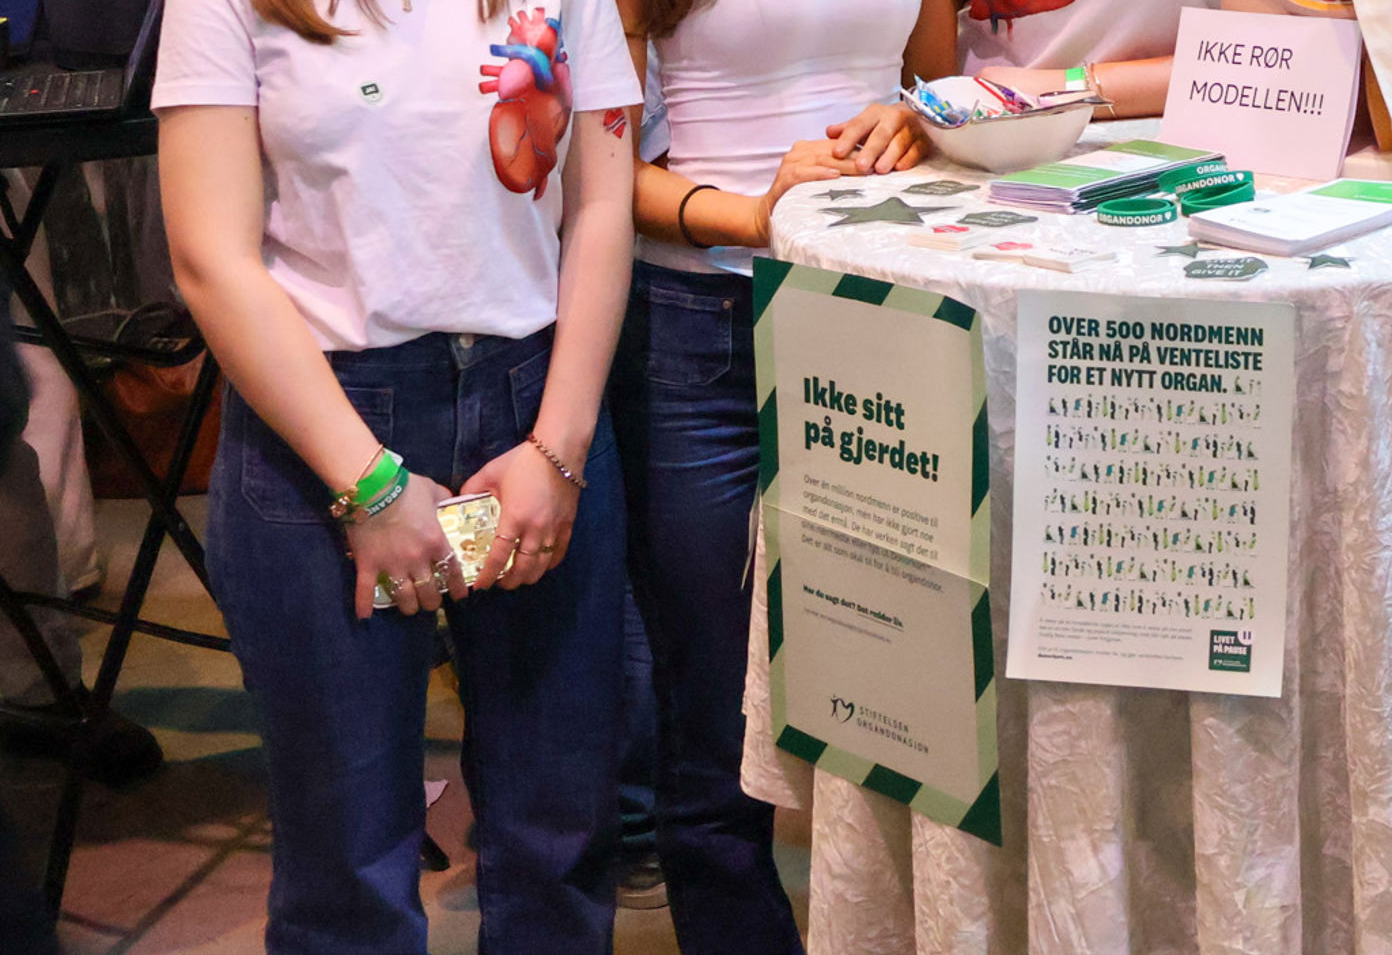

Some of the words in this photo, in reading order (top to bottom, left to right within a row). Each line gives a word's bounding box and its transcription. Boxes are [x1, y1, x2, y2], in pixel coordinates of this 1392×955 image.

[1197, 40, 1245, 65] IKKE
[1249, 45, 1293, 70] RØR
[1189, 80, 1324, 116] MODELLEN!!!
[1048, 316, 1100, 337] OVER
[1106, 320, 1144, 340] 500
[1150, 322, 1264, 346] NORDMENN
[1048, 338, 1094, 361] STÅR
[1099, 341, 1124, 362] NÅ
[1129, 342, 1151, 364] PÅ
[1156, 346, 1263, 371] VENTELISTE
[1047, 365, 1081, 385] FOR
[1086, 366, 1107, 385] ET
[1110, 367, 1157, 389] NYTT
[1161, 371, 1228, 394] ORGAN.
[803, 376, 857, 415] Ikke
[862, 392, 905, 430] sitt
[804, 416, 834, 450] på
[840, 426, 940, 482] gjerdet!
[804, 474, 819, 485] Over
[831, 484, 854, 498] million
[856, 493, 891, 511] nordmenn
[901, 509, 929, 525] positive
[803, 506, 817, 517] med
[851, 521, 860, 532] De
[856, 509, 871, 520] men
[873, 513, 884, 524] har
[886, 517, 899, 531] ikke
[901, 524, 918, 537] gjort
